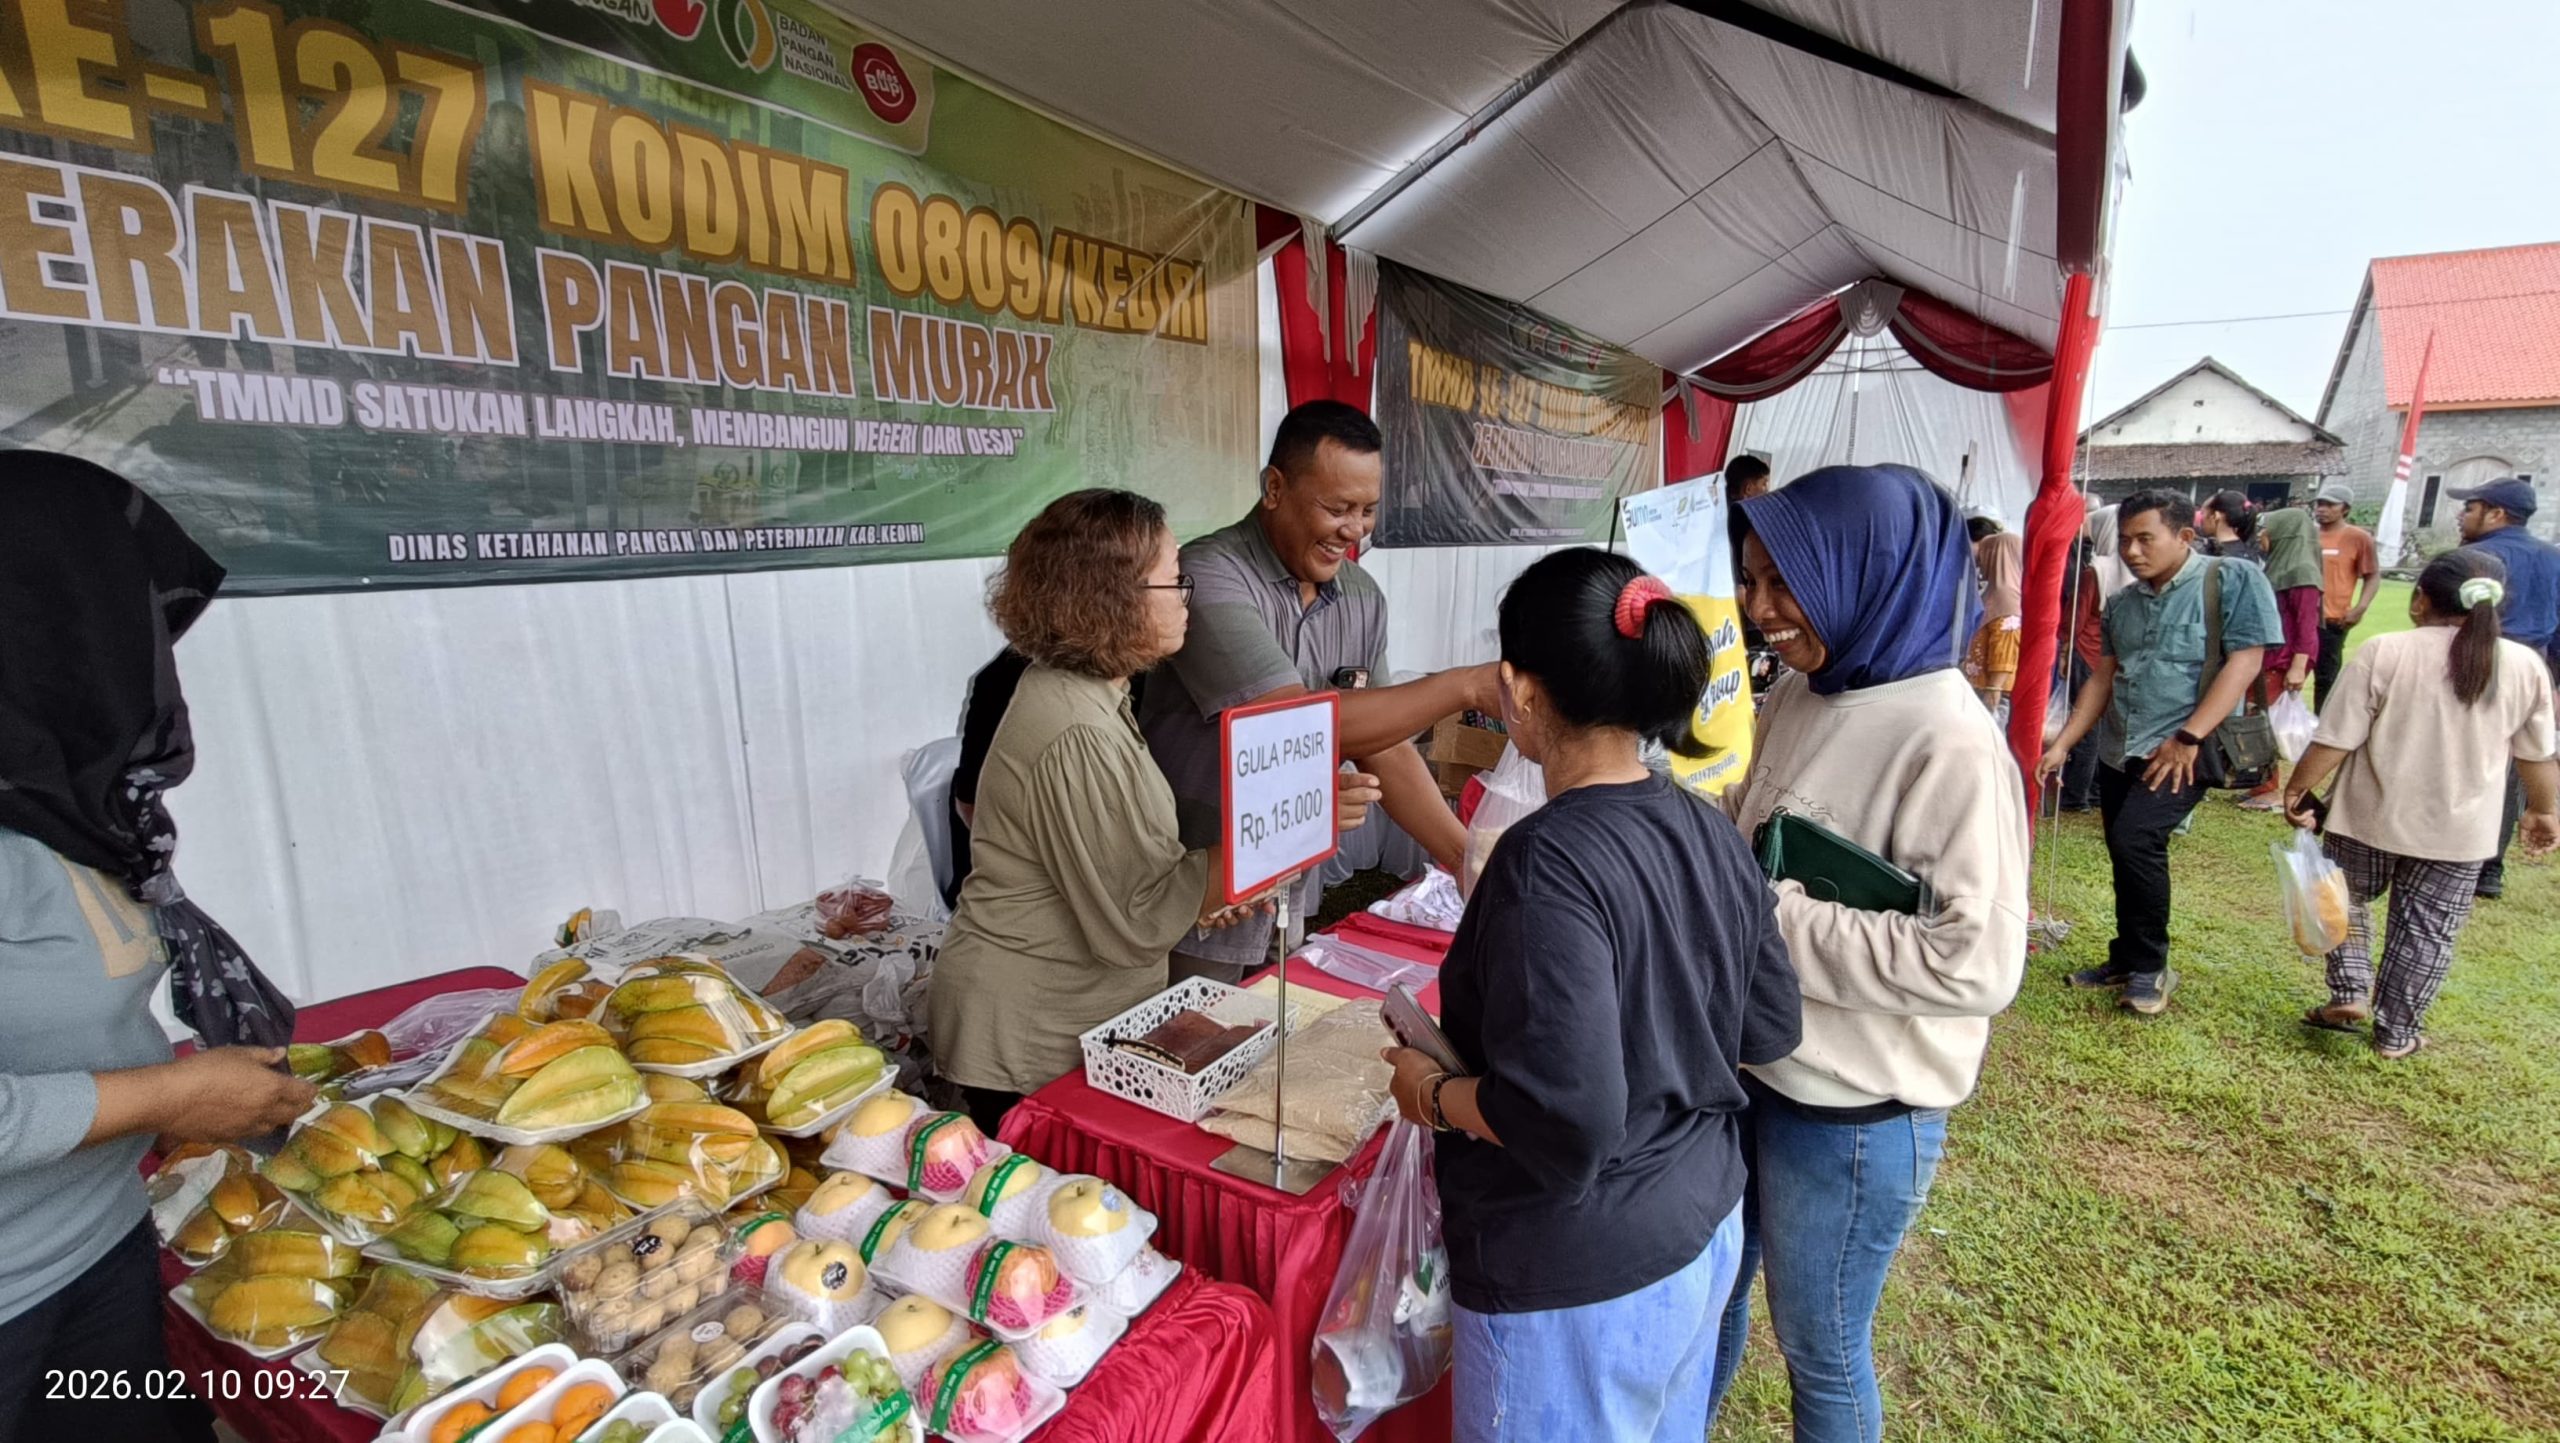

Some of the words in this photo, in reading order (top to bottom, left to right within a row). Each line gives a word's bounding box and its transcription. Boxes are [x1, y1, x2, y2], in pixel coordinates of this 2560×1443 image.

[778, 15, 827, 46] BADAN
[781, 36, 835, 69] PANGAN
[784, 55, 851, 91] NASIONAL
[0, 0, 480, 207] E-127
[527, 82, 853, 283] KODIM
[873, 184, 1207, 344] 0809/KEDIRI
[536, 247, 855, 398] PANGAN
[867, 305, 1057, 412] MURAH
[158, 366, 345, 426] “TMMD
[355, 383, 527, 435] SATUKAN
[535, 397, 685, 447] LANGKAH,
[691, 408, 849, 450] MEMBANGUN
[854, 420, 918, 453] NEGERI
[922, 425, 965, 454] DARI
[389, 534, 468, 561] DINAS
[477, 531, 610, 559] KETAHANAN
[616, 530, 695, 555] PANGAN
[701, 529, 739, 551] DAN
[745, 526, 845, 550] PETERNAKAN
[849, 524, 924, 545] KAB.KEDIRI
[1237, 741, 1280, 778] GULA
[1283, 731, 1326, 765] PASIR
[1240, 787, 1324, 850] Rp.15.000
